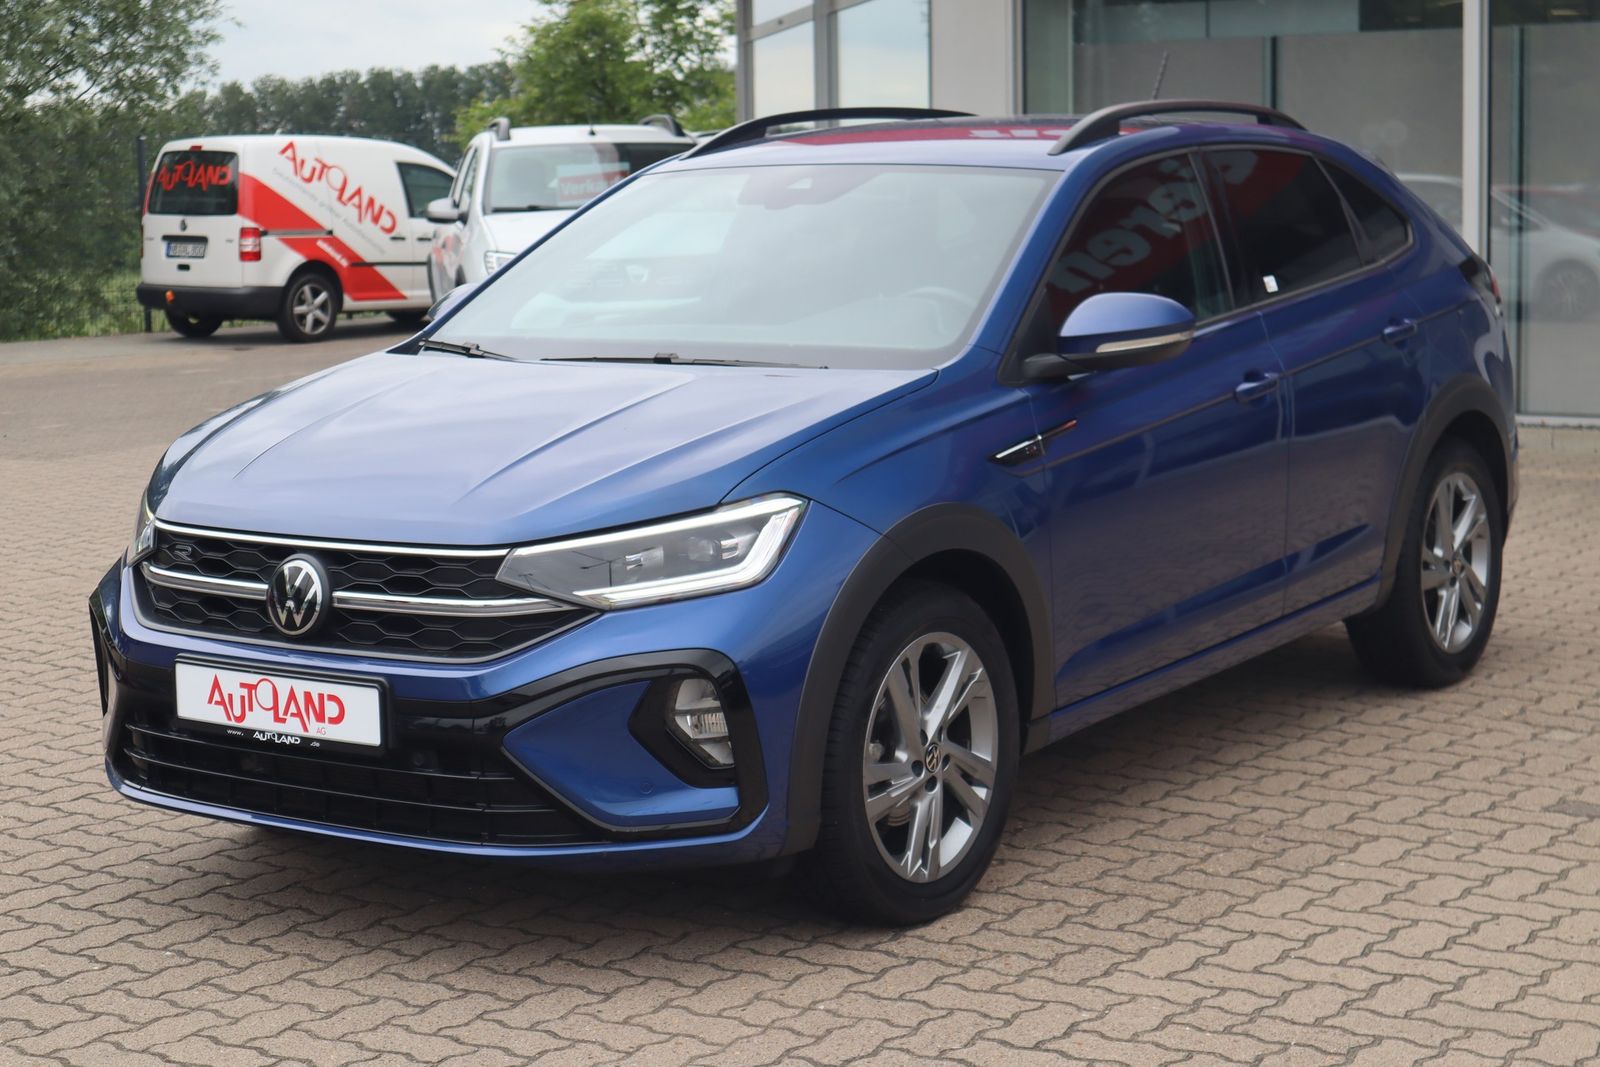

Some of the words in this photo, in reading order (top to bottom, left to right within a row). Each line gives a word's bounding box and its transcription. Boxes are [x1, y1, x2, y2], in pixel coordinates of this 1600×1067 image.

[157, 160, 232, 192] AUTOLAND
[278, 140, 397, 234] AUTOLAND
[207, 673, 346, 733] AUTOLAND
[253, 731, 301, 745] AUTOLAND
[316, 727, 327, 736] AG
